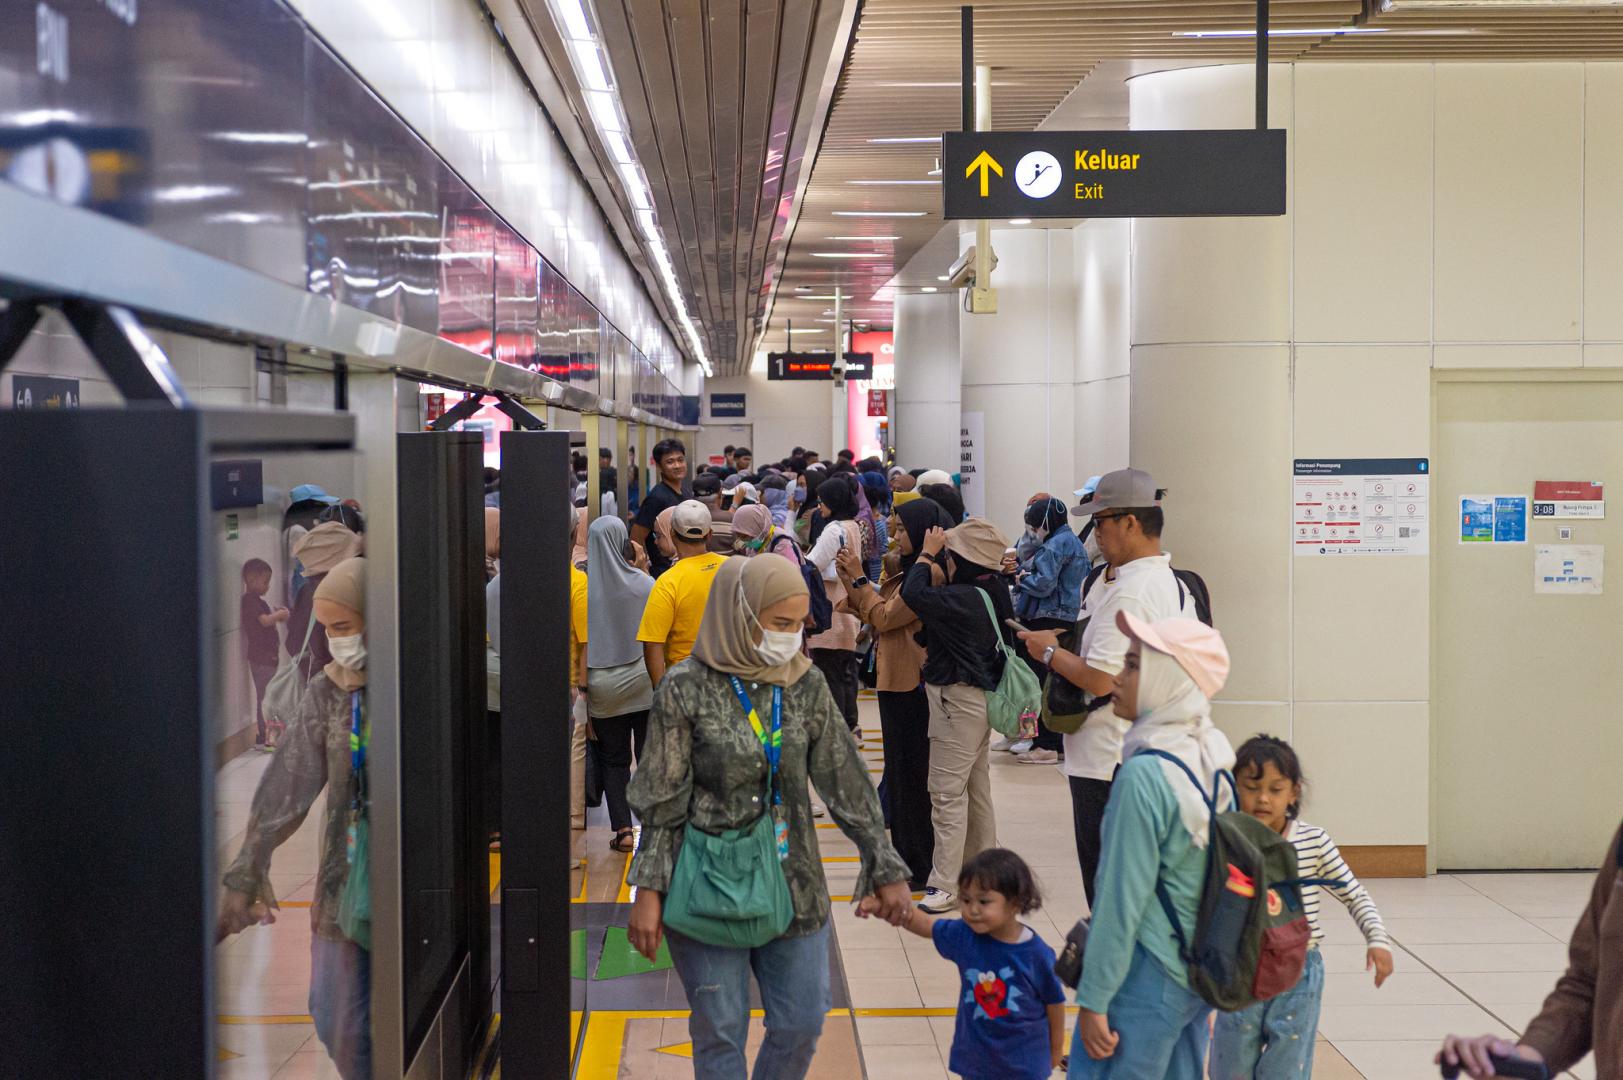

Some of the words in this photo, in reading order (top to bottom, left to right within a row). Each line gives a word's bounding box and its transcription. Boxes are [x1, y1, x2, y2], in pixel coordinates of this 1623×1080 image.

[1074, 148, 1140, 171] Keluar
[1074, 182, 1104, 199] Exit
[775, 358, 784, 376] 1
